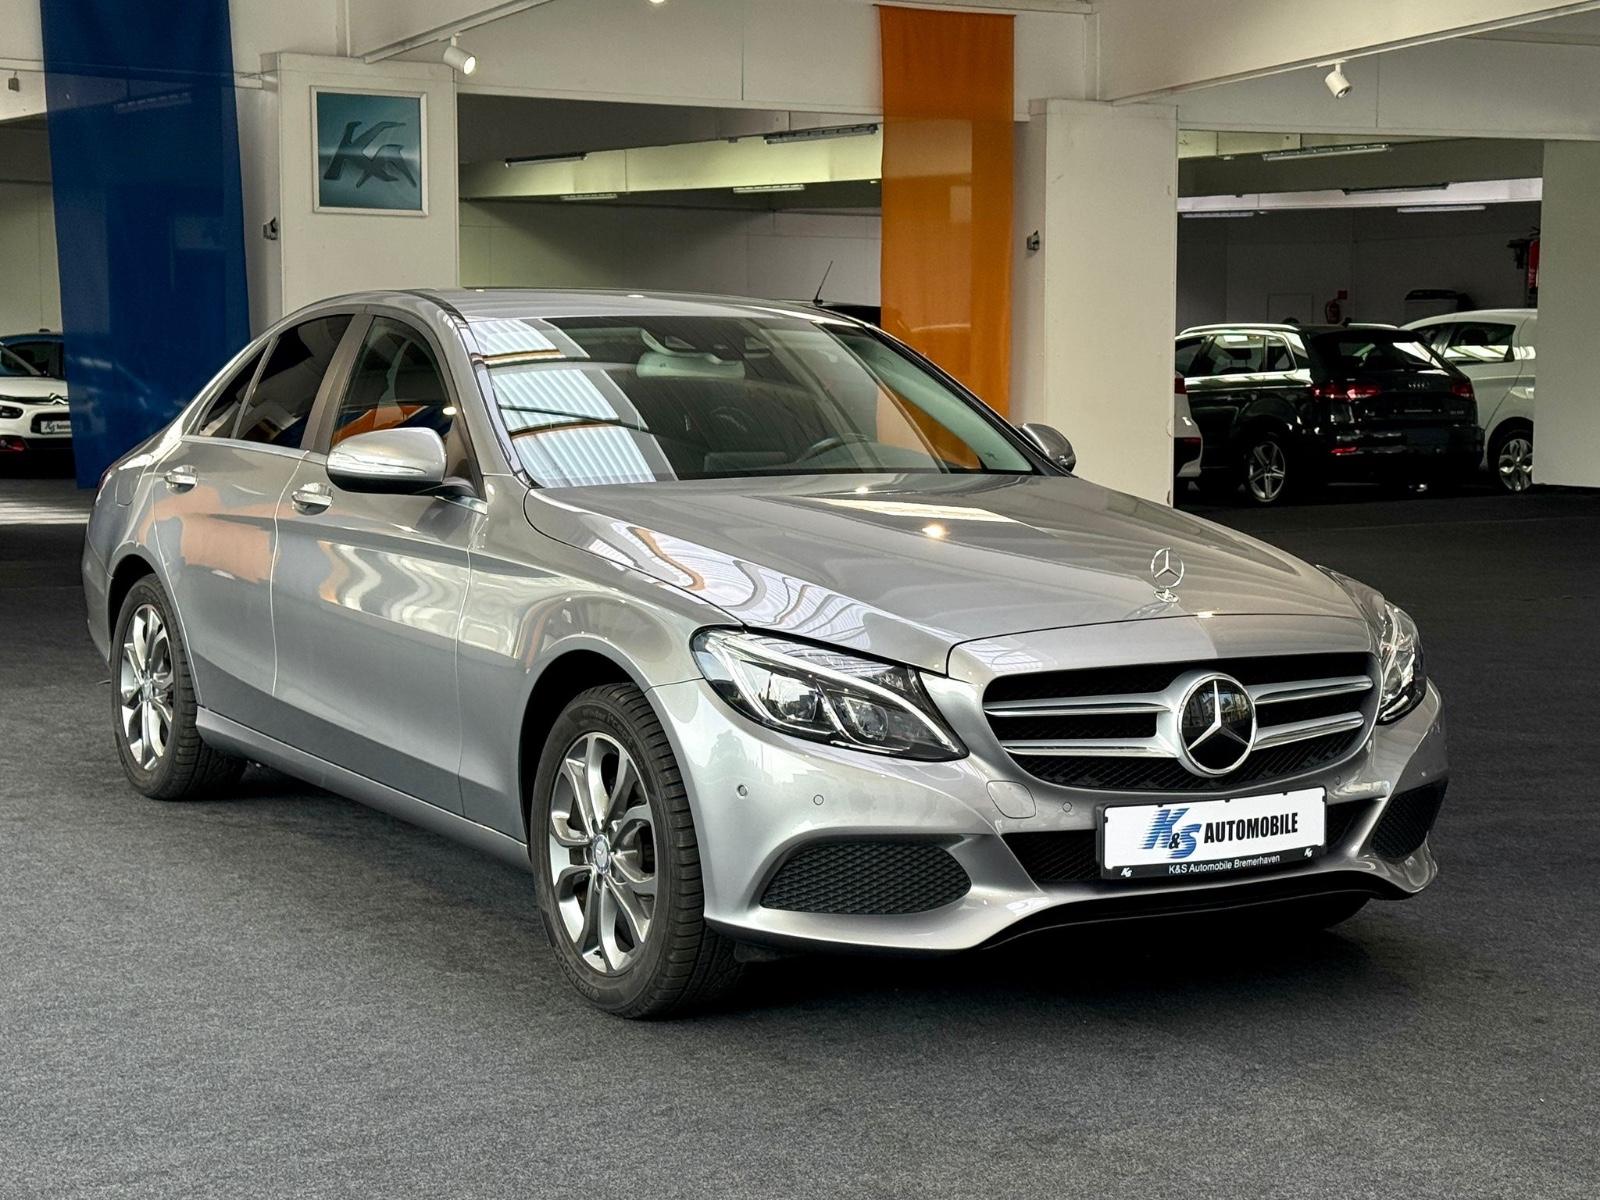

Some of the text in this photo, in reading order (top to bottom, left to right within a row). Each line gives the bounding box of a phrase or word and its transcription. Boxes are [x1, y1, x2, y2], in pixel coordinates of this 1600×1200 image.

[1137, 807, 1299, 859] K&S AUTOMOBILE
[1168, 854, 1281, 875] K&S Automobile Bremerhaven
